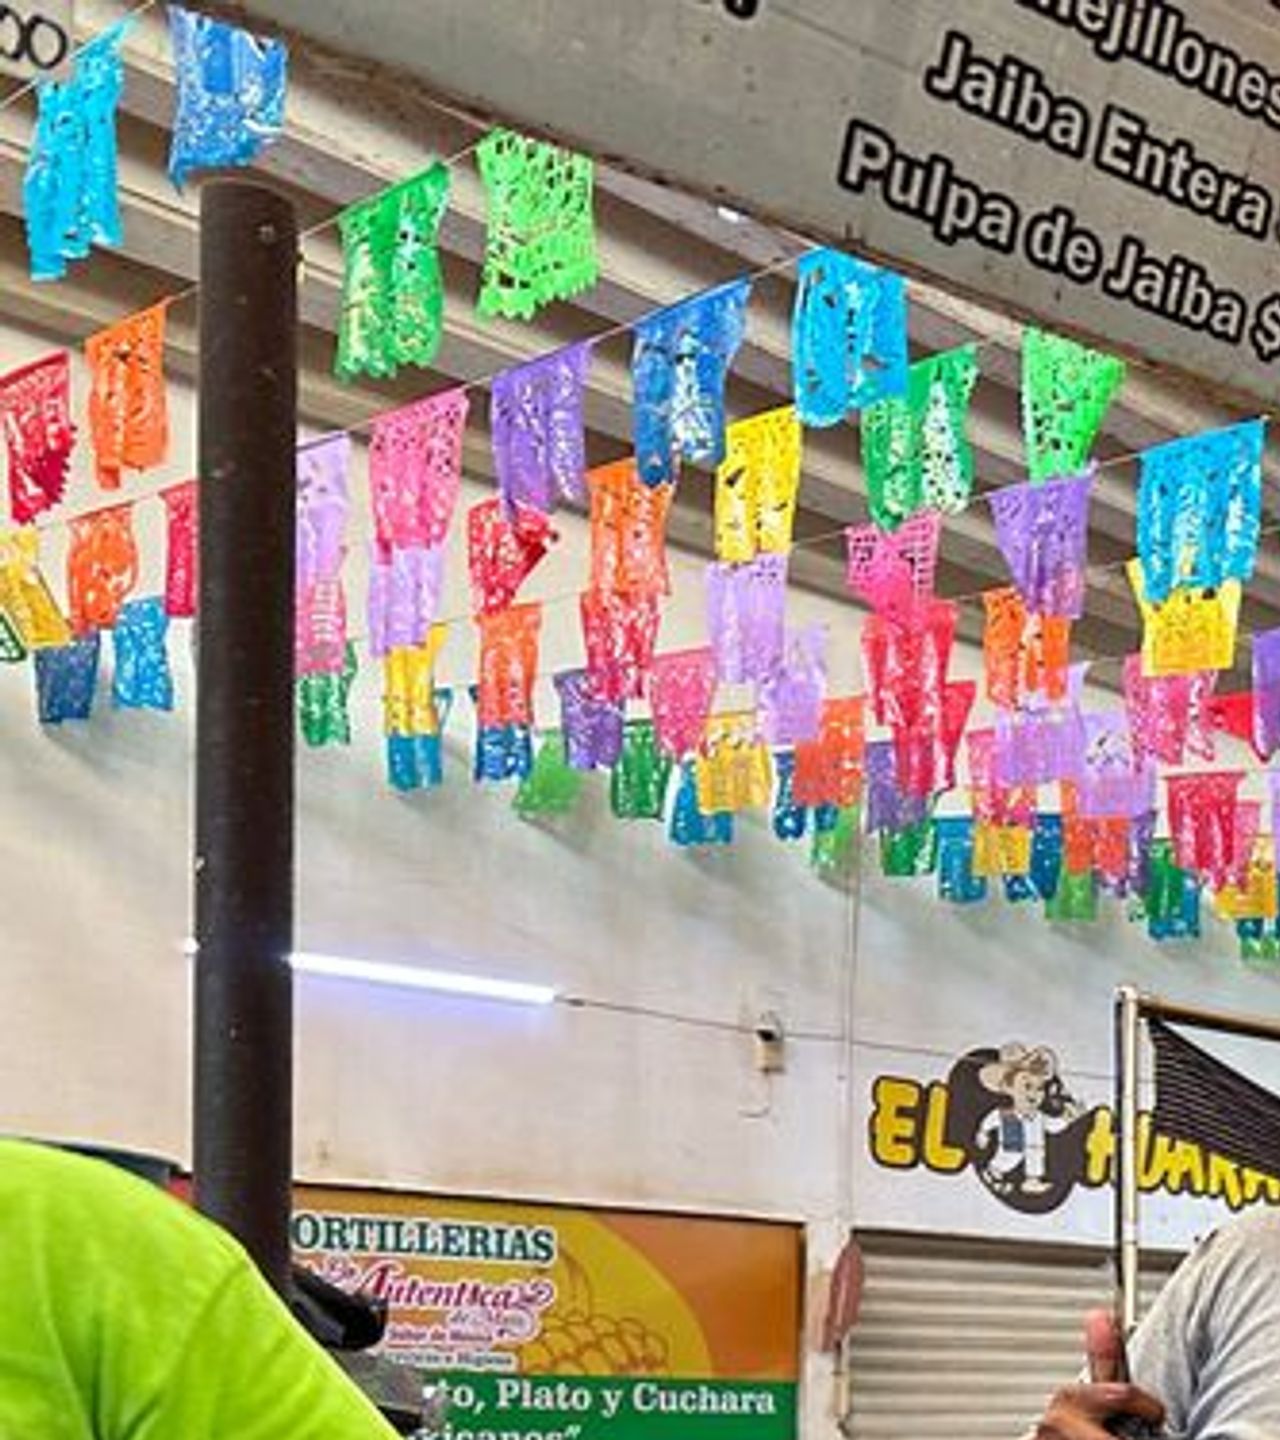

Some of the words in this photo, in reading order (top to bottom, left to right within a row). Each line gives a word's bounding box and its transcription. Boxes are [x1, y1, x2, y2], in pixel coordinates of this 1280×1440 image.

[924, 30, 1090, 159] Jaiba
[1095, 103, 1272, 240] Entera
[841, 121, 1016, 254] Pulpa
[1025, 206, 1100, 286] de
[1102, 235, 1246, 344] Jaiba
[869, 1075, 970, 1174] EL
[292, 1213, 556, 1262] ORTILLERIAS
[495, 1378, 593, 1412] Plato
[601, 1389, 624, 1418] y
[632, 1382, 777, 1416] Cuchara
